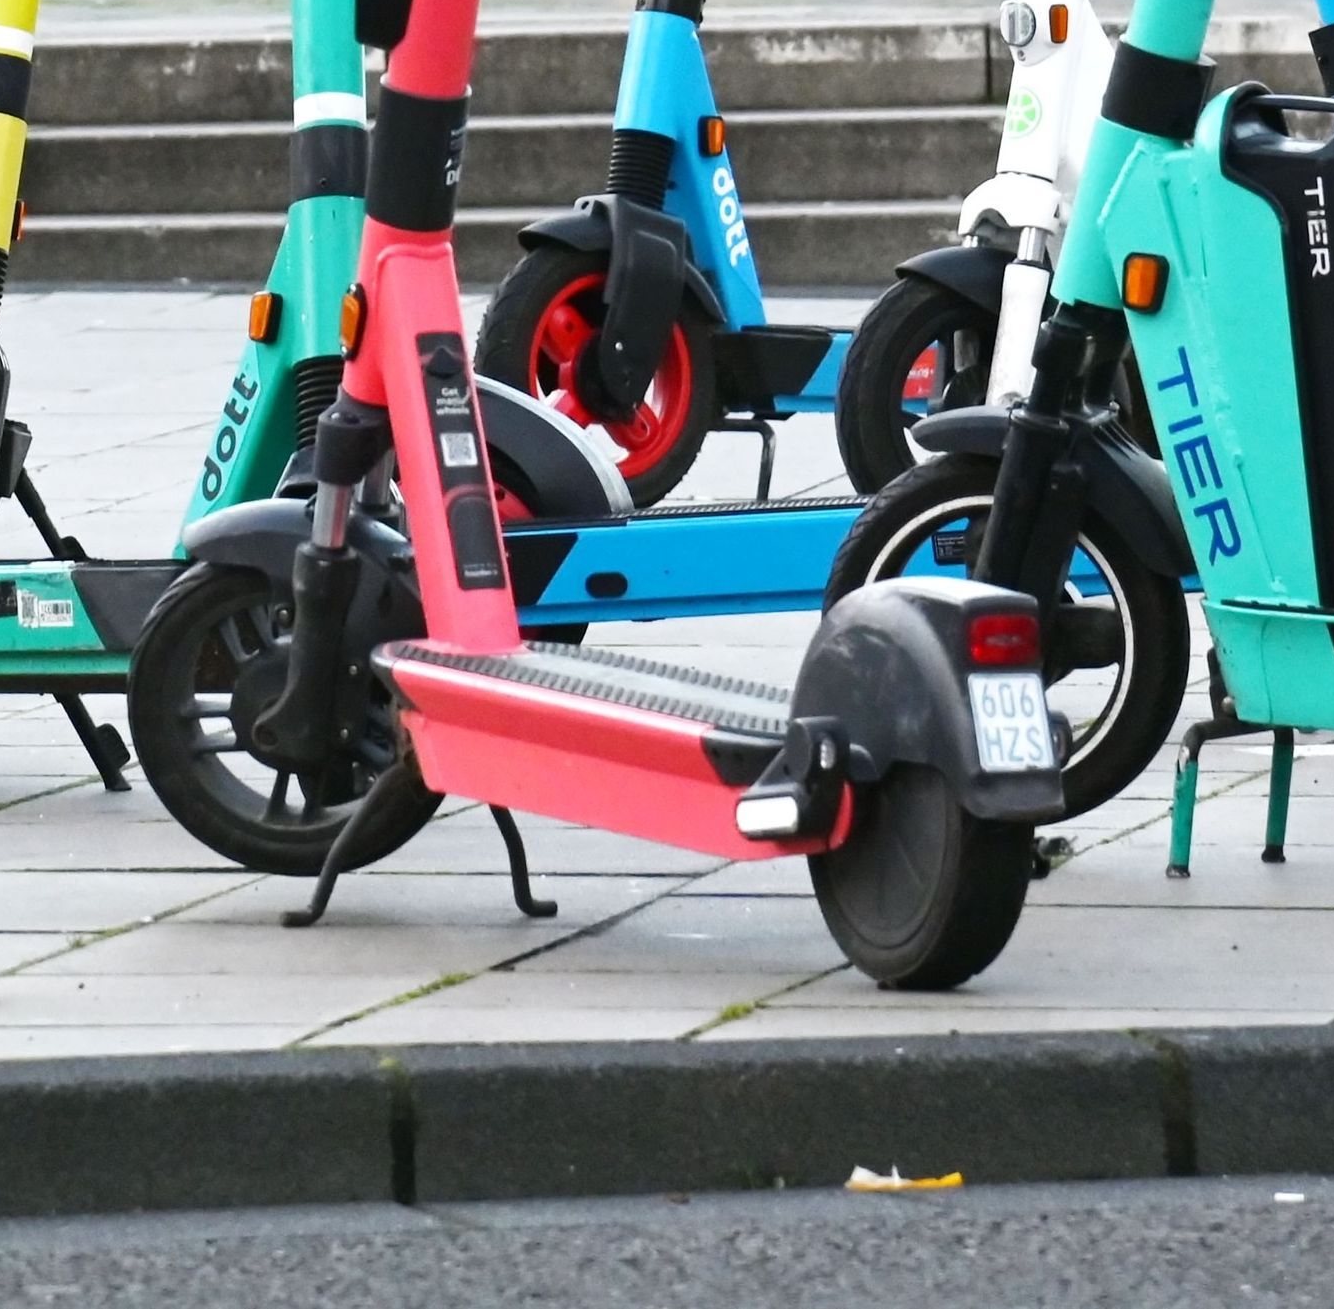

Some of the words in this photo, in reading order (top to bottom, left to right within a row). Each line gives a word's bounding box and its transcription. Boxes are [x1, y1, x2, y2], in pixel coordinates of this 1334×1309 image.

[712, 166, 749, 267] dott
[1304, 176, 1331, 278] TIER
[202, 372, 258, 501] dott
[1157, 345, 1242, 566] TIER
[982, 682, 1035, 718] 606
[984, 726, 1044, 763] HZS
